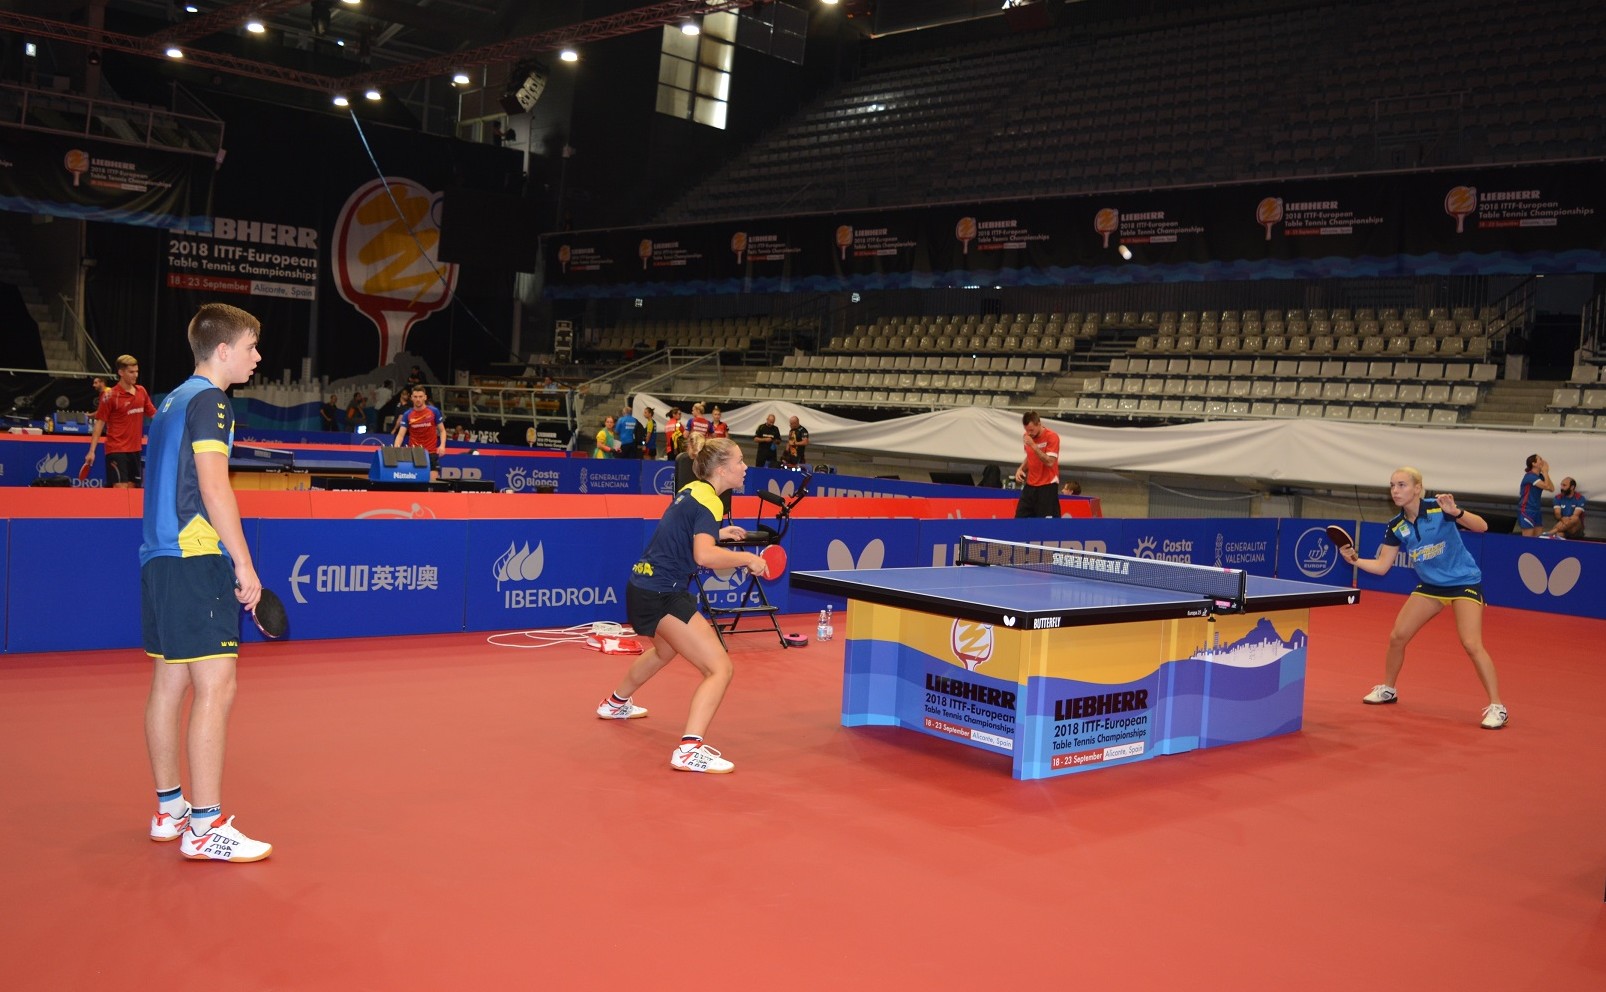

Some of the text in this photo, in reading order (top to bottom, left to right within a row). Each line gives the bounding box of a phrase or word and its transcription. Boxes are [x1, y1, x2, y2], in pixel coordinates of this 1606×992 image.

[1480, 190, 1541, 201] LIEBHERR
[1285, 201, 1339, 211] LIEBHERR
[1501, 201, 1558, 210] ITTF-European
[1479, 211, 1500, 219] Table
[1530, 207, 1594, 217] Championships
[169, 217, 318, 249] BHERR
[169, 240, 318, 268] 2018 ITTF-European
[168, 256, 317, 281] Table Tennis Championships
[170, 275, 181, 285] 18
[188, 277, 200, 287] 23
[203, 278, 249, 291] September
[254, 284, 312, 297] Alicante, Spain
[532, 469, 559, 479] Costa
[590, 473, 631, 481] GENERALITAT
[526, 477, 559, 487] Blanca
[1163, 539, 1192, 552] Costa
[1225, 541, 1267, 552] GENERALITAT
[1225, 553, 1265, 563] VALENCIANA
[505, 586, 618, 609] IBERDROLA
[1033, 617, 1061, 629] BUTTERFLY
[926, 673, 1016, 710] LIEBHERR
[925, 692, 1015, 724] 2018 ITTF-European
[1054, 689, 1148, 721] LIEBHERR
[924, 704, 1015, 734] Table Tennis Championships
[943, 723, 970, 737] September
[1054, 715, 1148, 738] 2018 ITTF-European
[996, 737, 1012, 748] Spain
[1053, 728, 1147, 750] Table Tennis Championships
[1129, 745, 1143, 754] Spain
[1053, 758, 1060, 767] 18
[1064, 756, 1072, 765] 23
[1073, 752, 1103, 765] September
